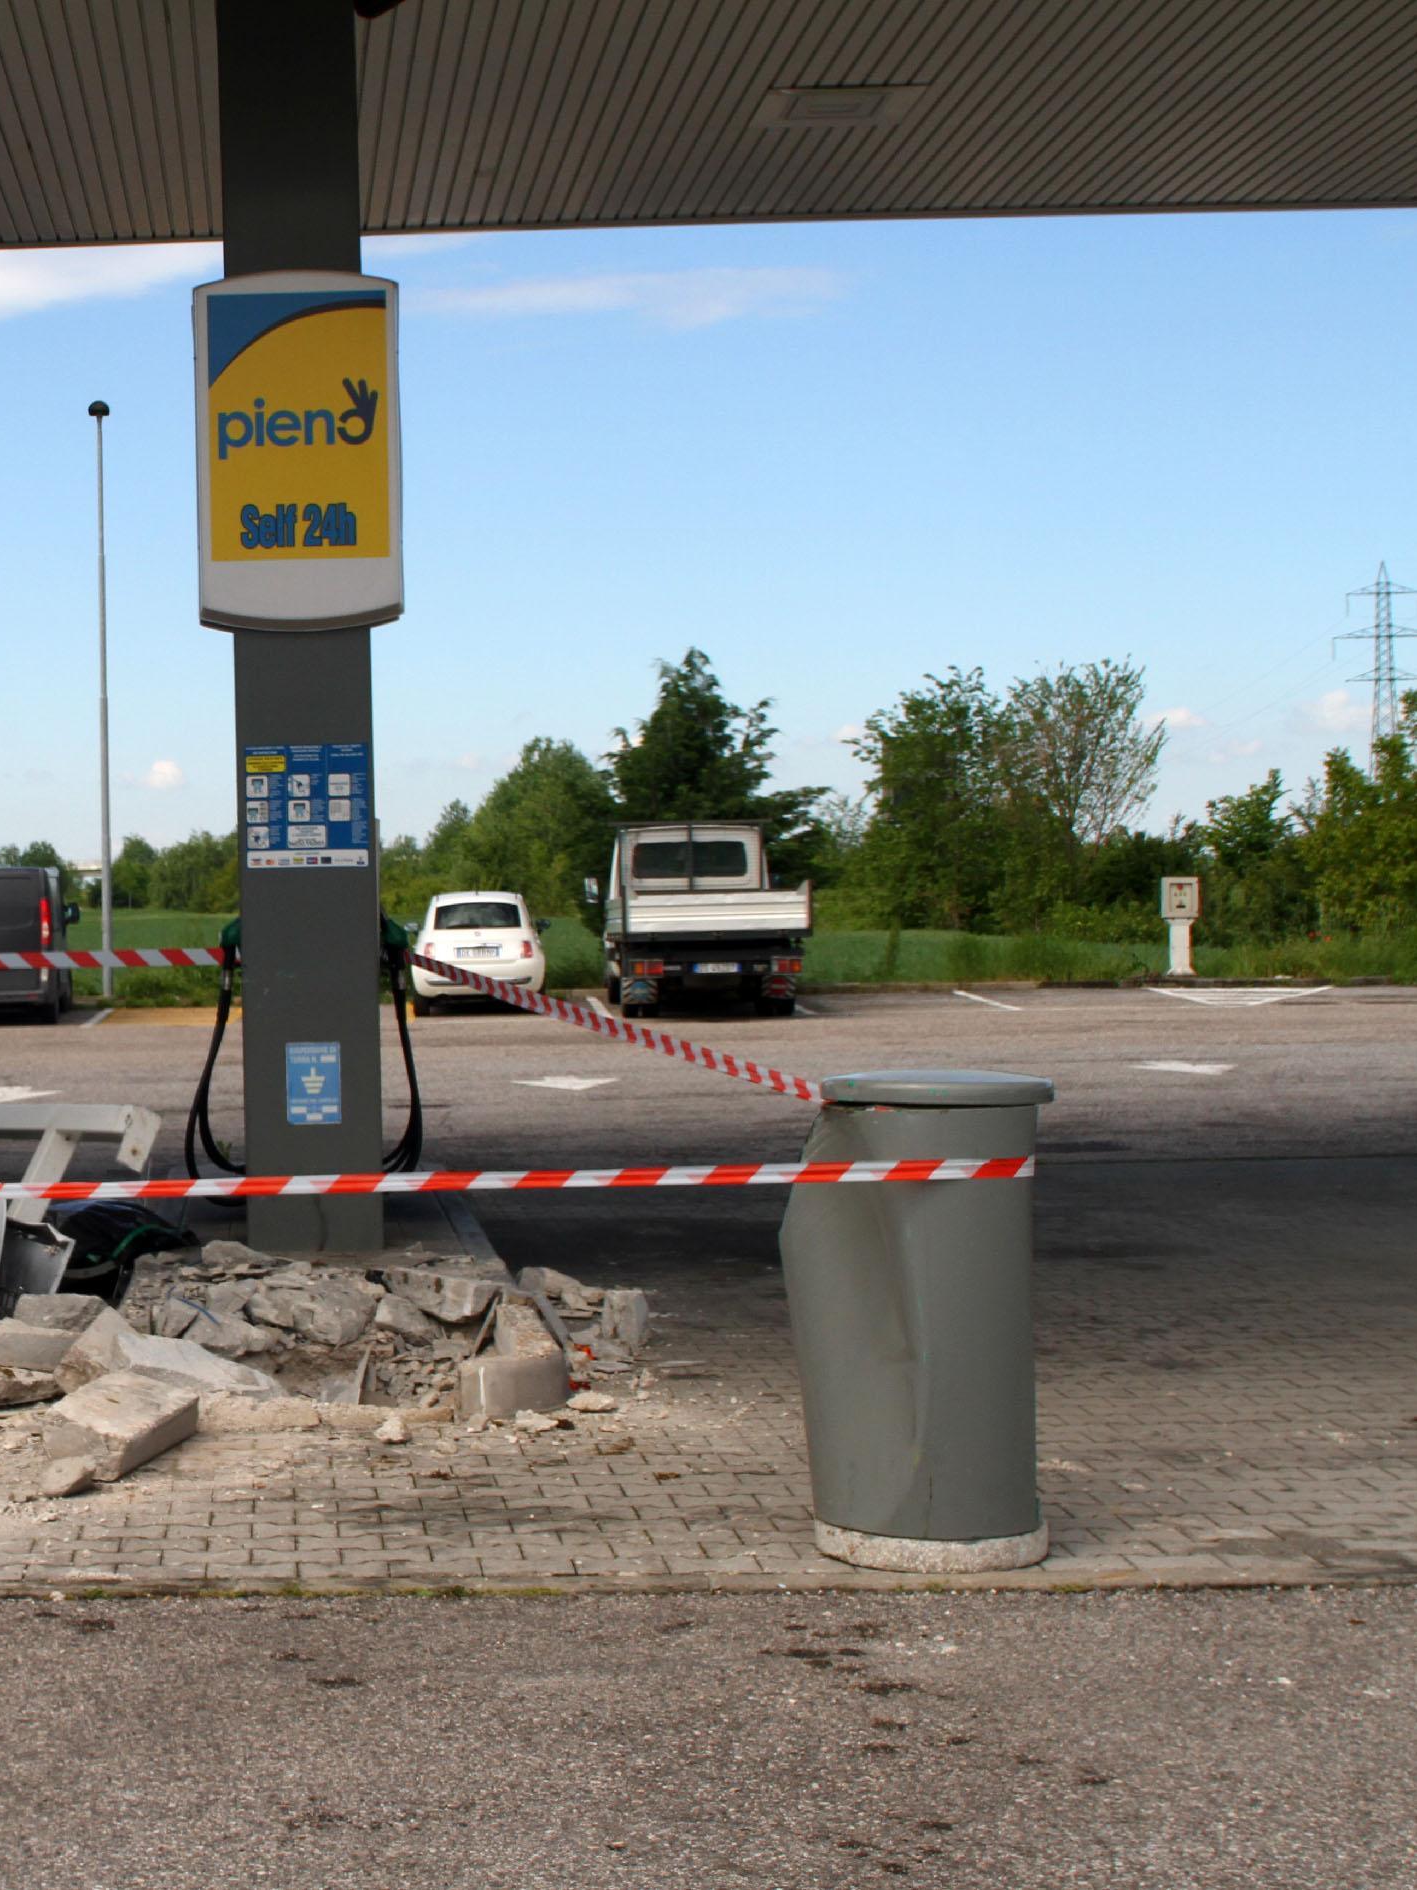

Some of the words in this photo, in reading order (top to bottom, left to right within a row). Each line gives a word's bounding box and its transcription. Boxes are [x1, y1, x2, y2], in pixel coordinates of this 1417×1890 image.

[217, 378, 379, 460] pieno
[239, 503, 297, 549] Self
[302, 502, 357, 547] 24h
